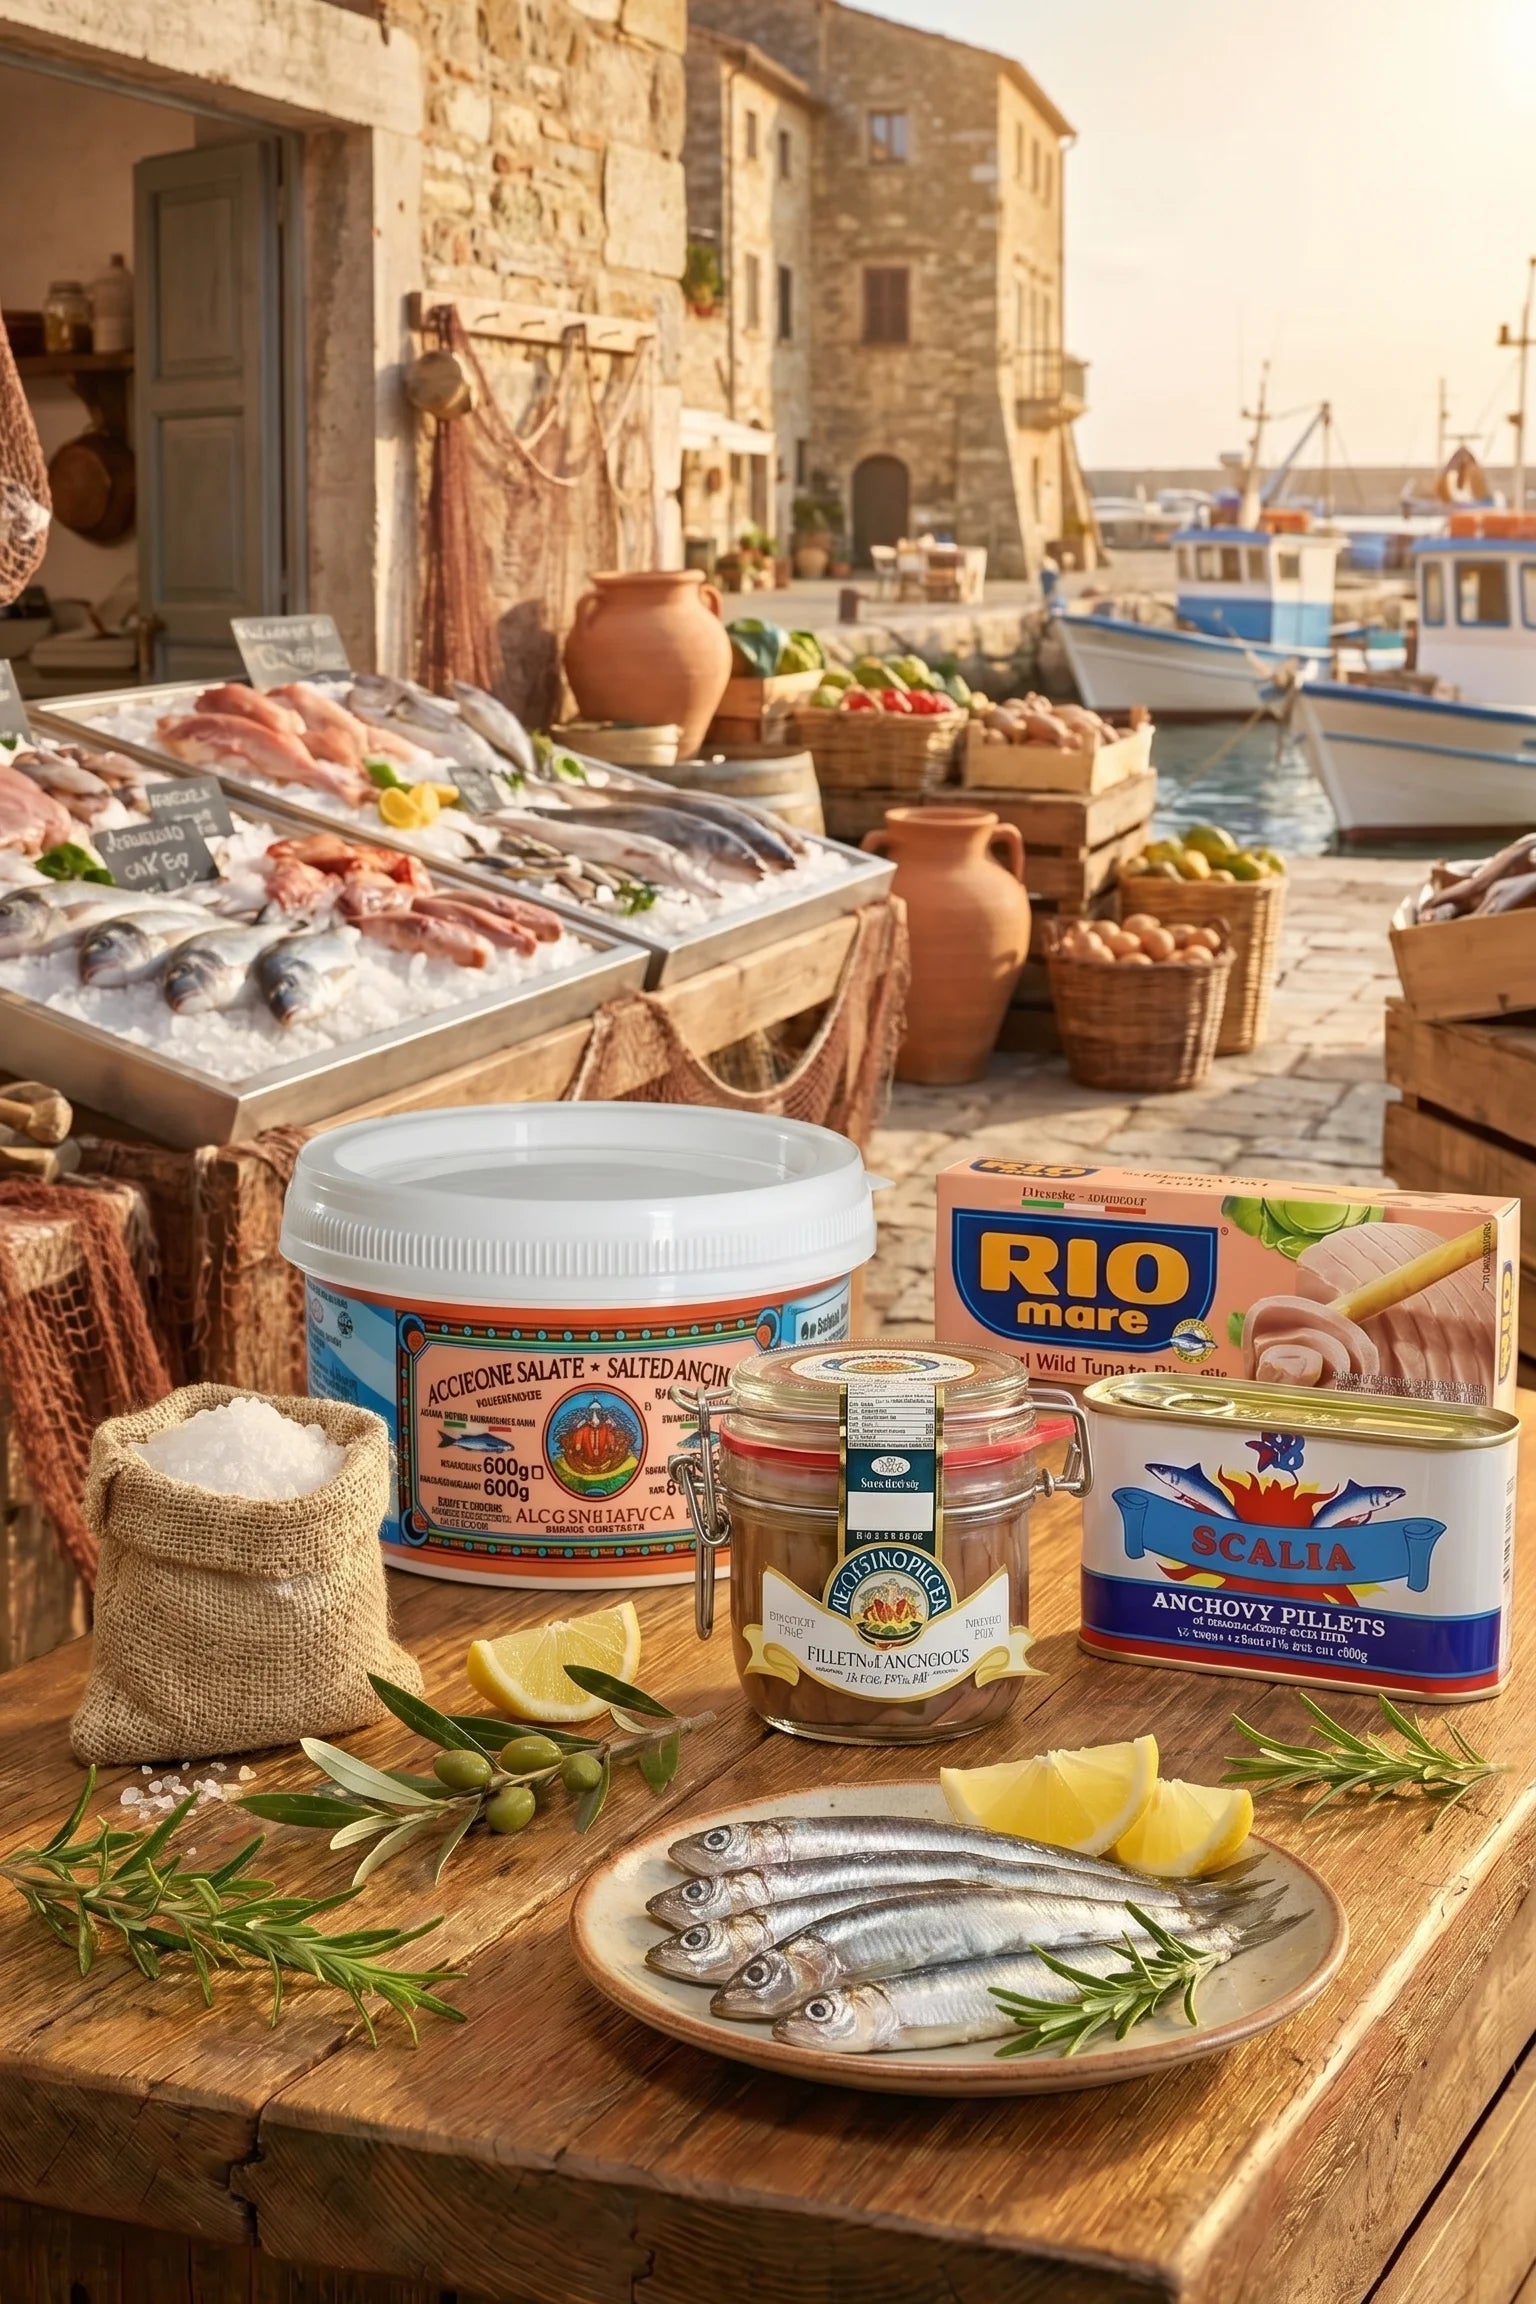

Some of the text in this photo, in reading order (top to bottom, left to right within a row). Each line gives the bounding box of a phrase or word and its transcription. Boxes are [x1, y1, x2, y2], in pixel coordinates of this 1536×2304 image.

[980, 1231, 1190, 1306] RIO
[1017, 1301, 1149, 1335] mare
[517, 1357, 585, 1383] SALATE
[607, 1357, 674, 1379] SALTED
[1037, 1352, 1076, 1373] Wild
[1082, 1357, 1125, 1377] Tuna
[483, 1456, 529, 1481] 600g
[483, 1478, 529, 1502] 600g
[1192, 1525, 1356, 1571] SCALIA
[1152, 1592, 1386, 1637] ANCHOVY PILLETS
